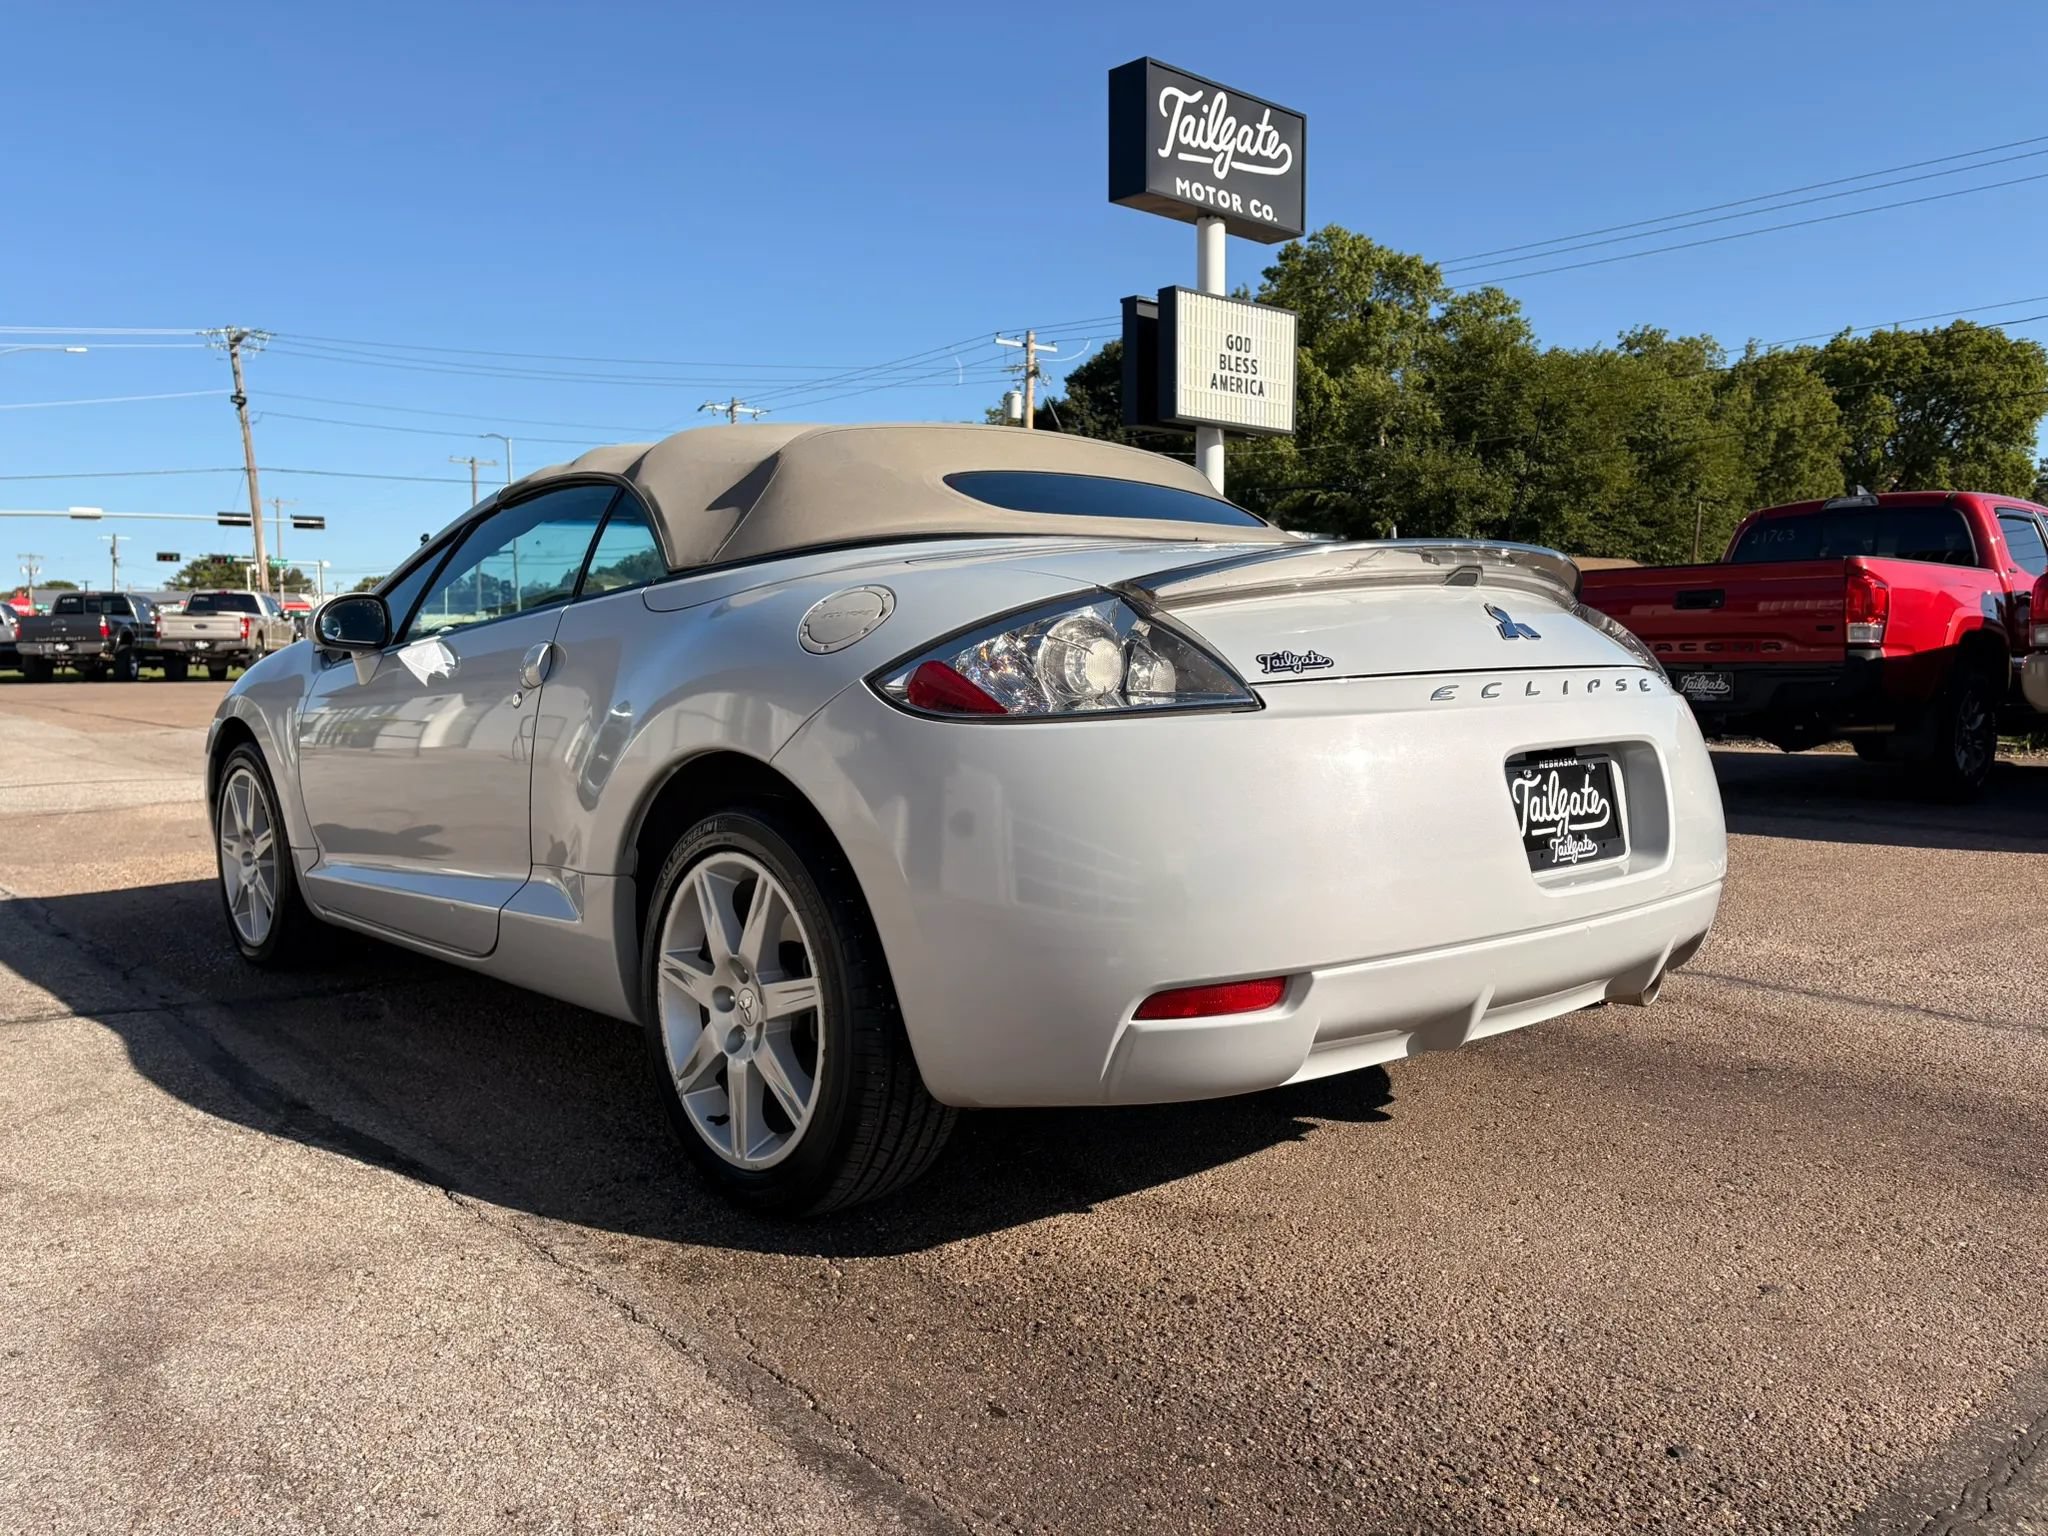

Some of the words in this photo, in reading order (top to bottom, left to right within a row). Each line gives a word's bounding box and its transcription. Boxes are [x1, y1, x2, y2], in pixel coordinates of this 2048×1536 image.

[1158, 86, 1293, 180] Tailgate
[1175, 176, 1244, 214] MOTOR
[1249, 198, 1279, 223] CO.
[1225, 333, 1252, 354] GOD
[1219, 353, 1259, 376] BLESS
[1210, 372, 1266, 398] AMERICA
[1645, 640, 1784, 653] ACOMA
[1257, 650, 1334, 674] Tailgate
[1430, 677, 1652, 702] ECLIPSE
[1679, 673, 1731, 695] Tailgate
[1538, 757, 1579, 769] NEBRASKA
[1511, 769, 1612, 838] Tailgate
[1549, 833, 1599, 864] Tailgate
